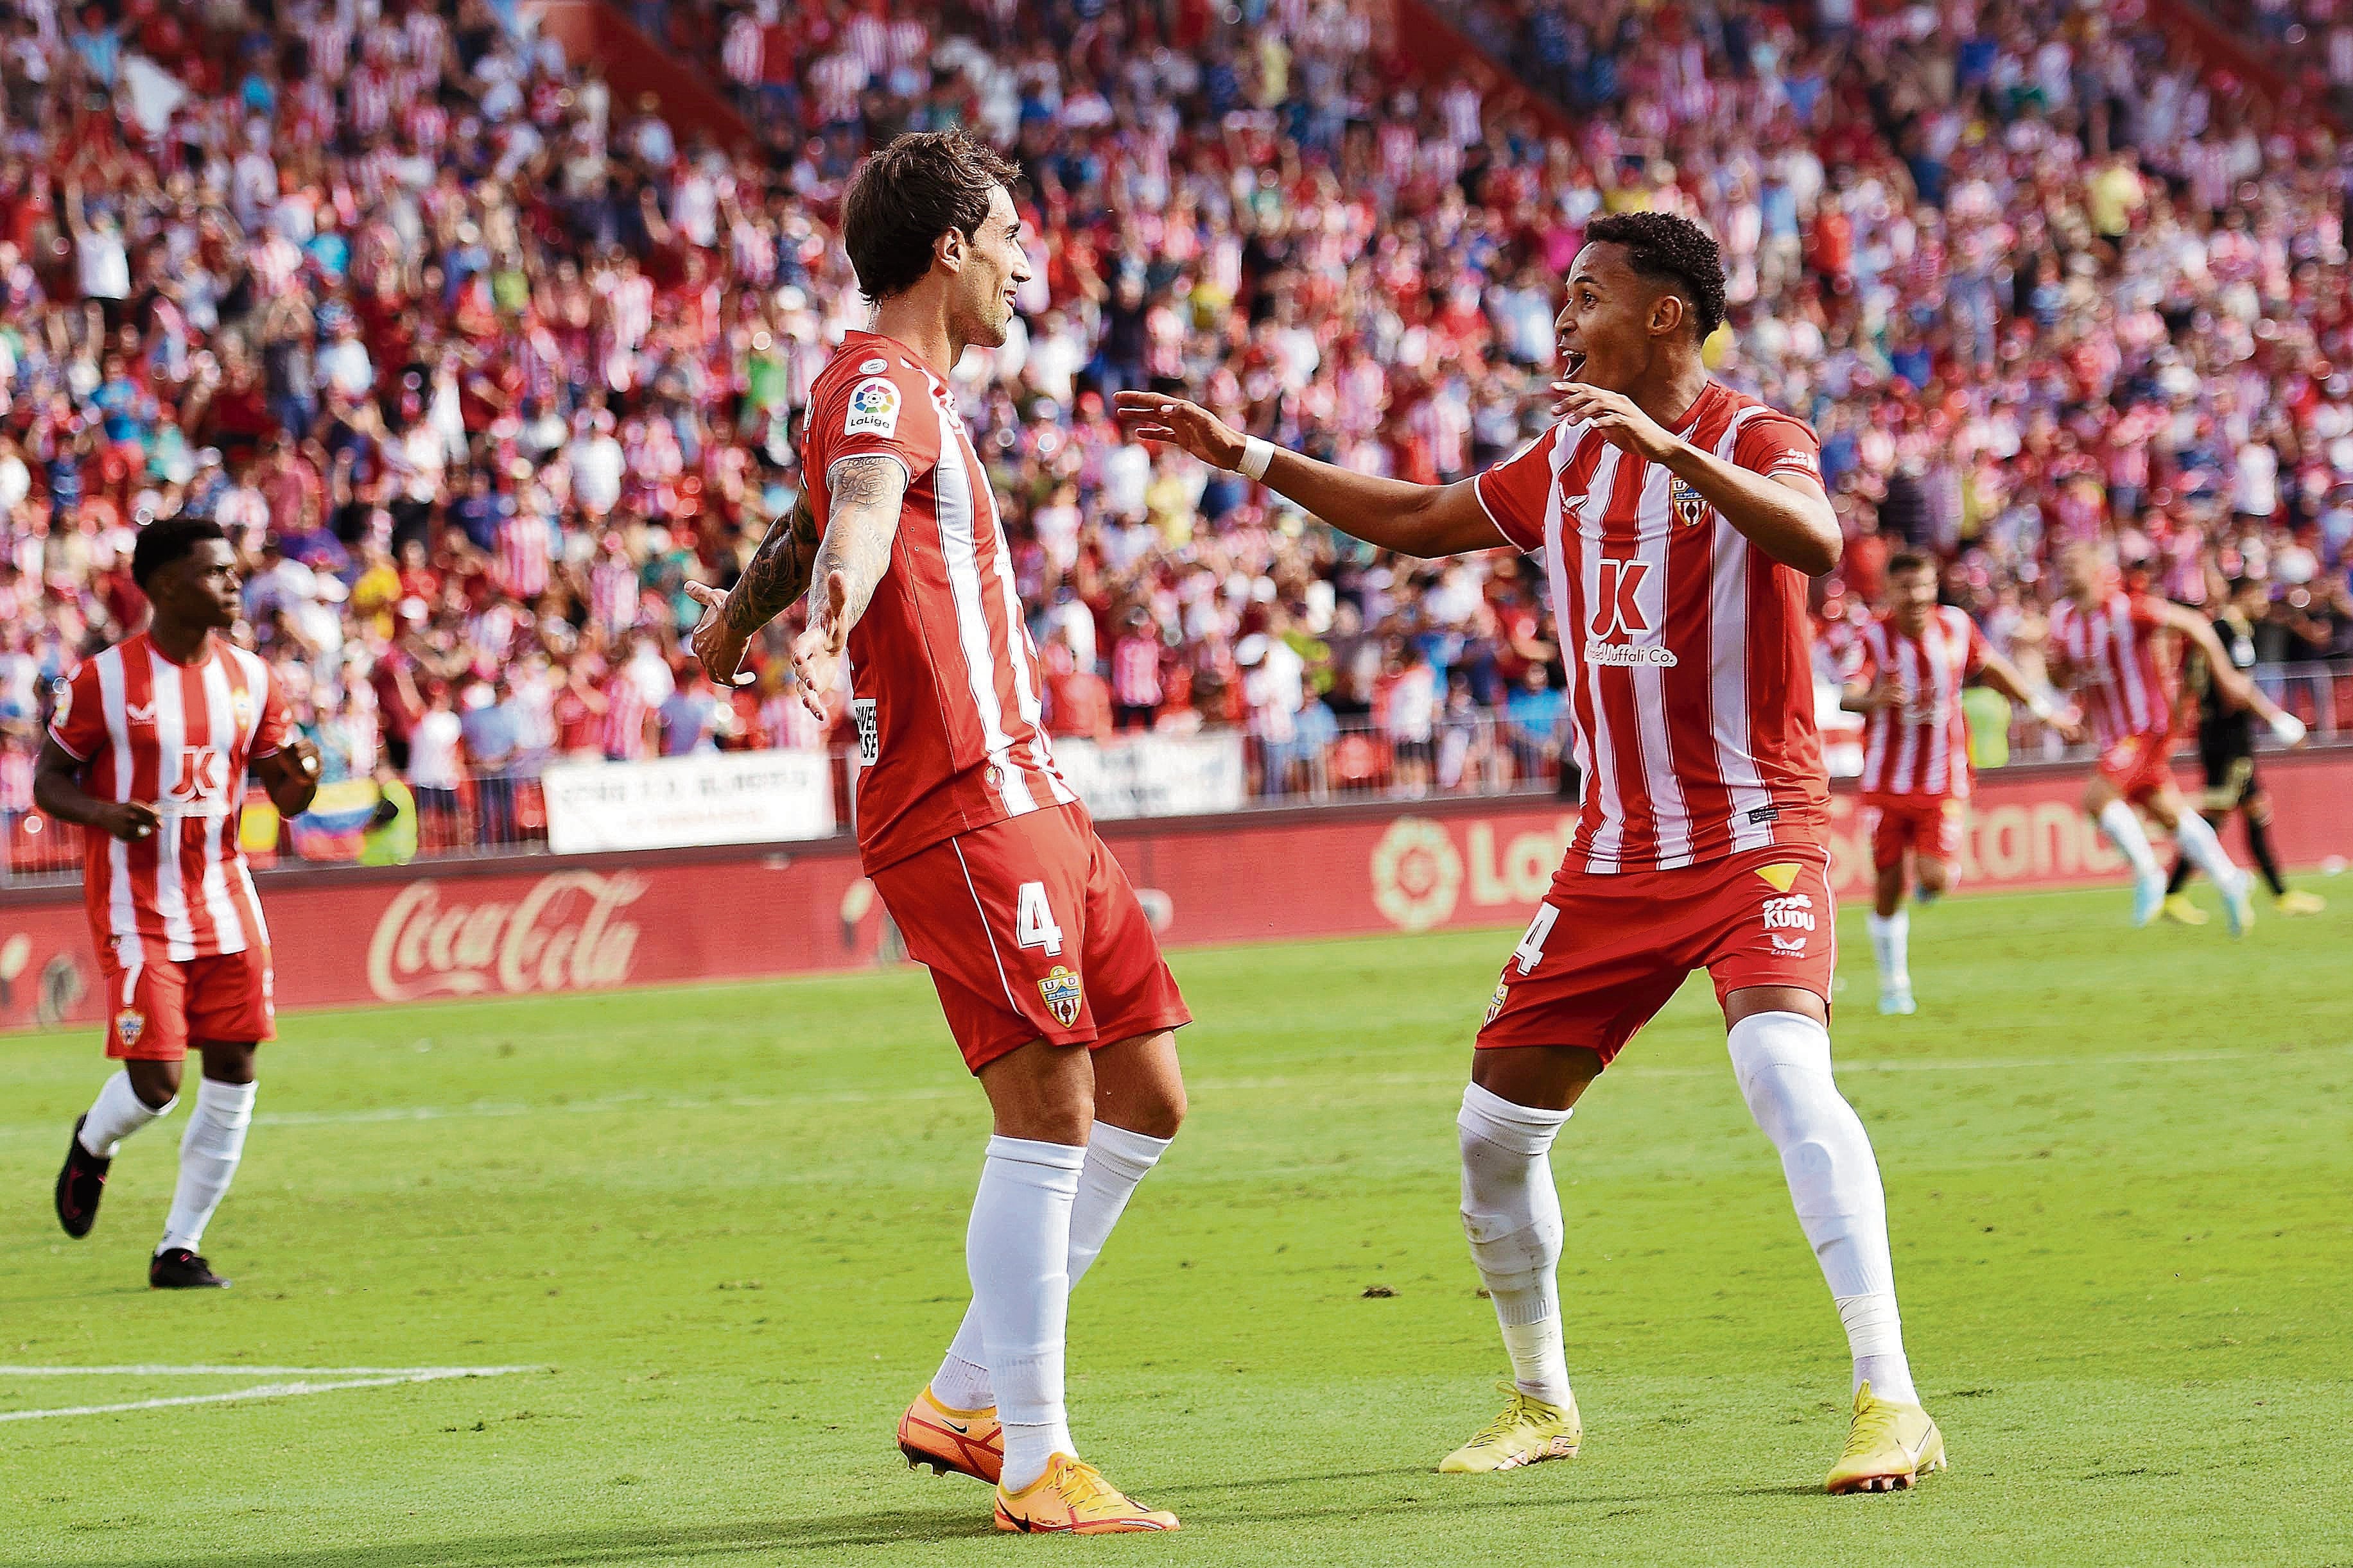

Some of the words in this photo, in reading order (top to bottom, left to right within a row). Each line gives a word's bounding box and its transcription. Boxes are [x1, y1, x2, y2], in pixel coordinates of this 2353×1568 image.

[851, 415, 890, 429] LaLiga
[1590, 563, 1650, 637] JK
[1649, 649, 1674, 662] Co.
[168, 750, 218, 798] JK
[1016, 881, 1063, 957] 4
[1513, 901, 1561, 976] 4
[1763, 909, 1816, 931] KUDU
